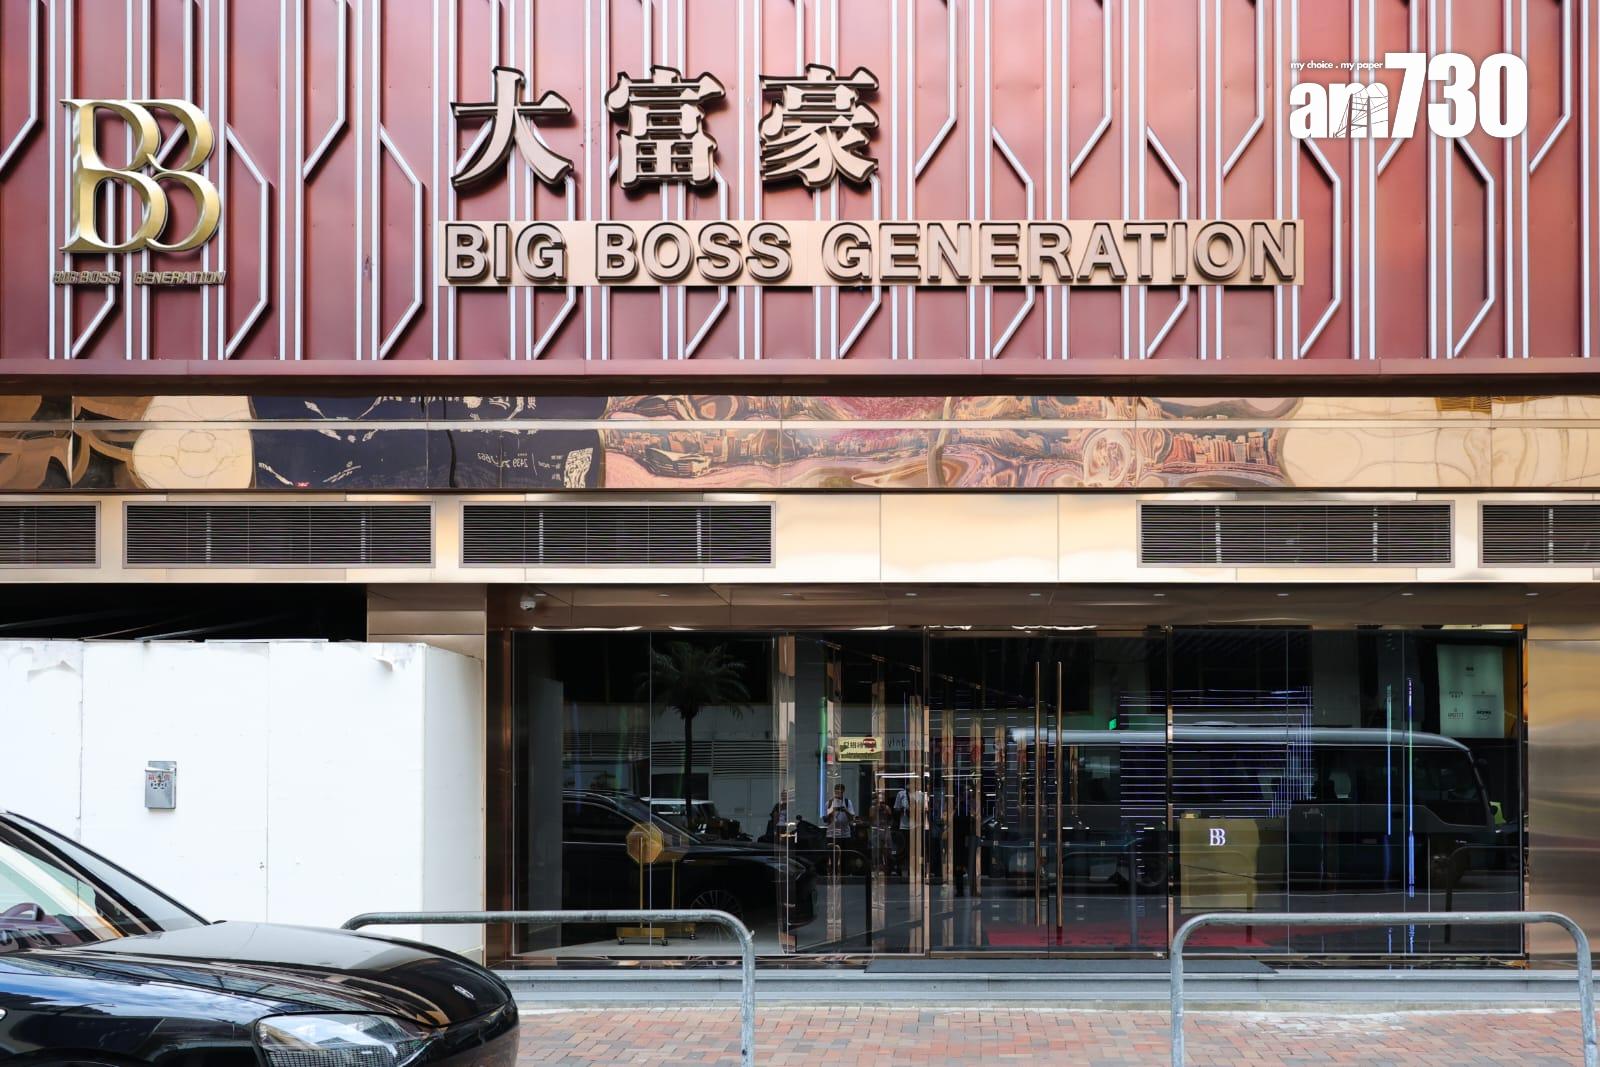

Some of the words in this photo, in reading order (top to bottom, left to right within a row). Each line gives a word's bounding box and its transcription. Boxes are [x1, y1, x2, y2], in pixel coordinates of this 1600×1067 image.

[450, 64, 880, 190] 大富豪
[54, 270, 79, 285] BIG
[79, 270, 121, 285] BOSS
[134, 270, 227, 285] GENERATION
[444, 222, 568, 284] BIG
[595, 222, 791, 284] BOSS
[821, 221, 1297, 284] GENERATION
